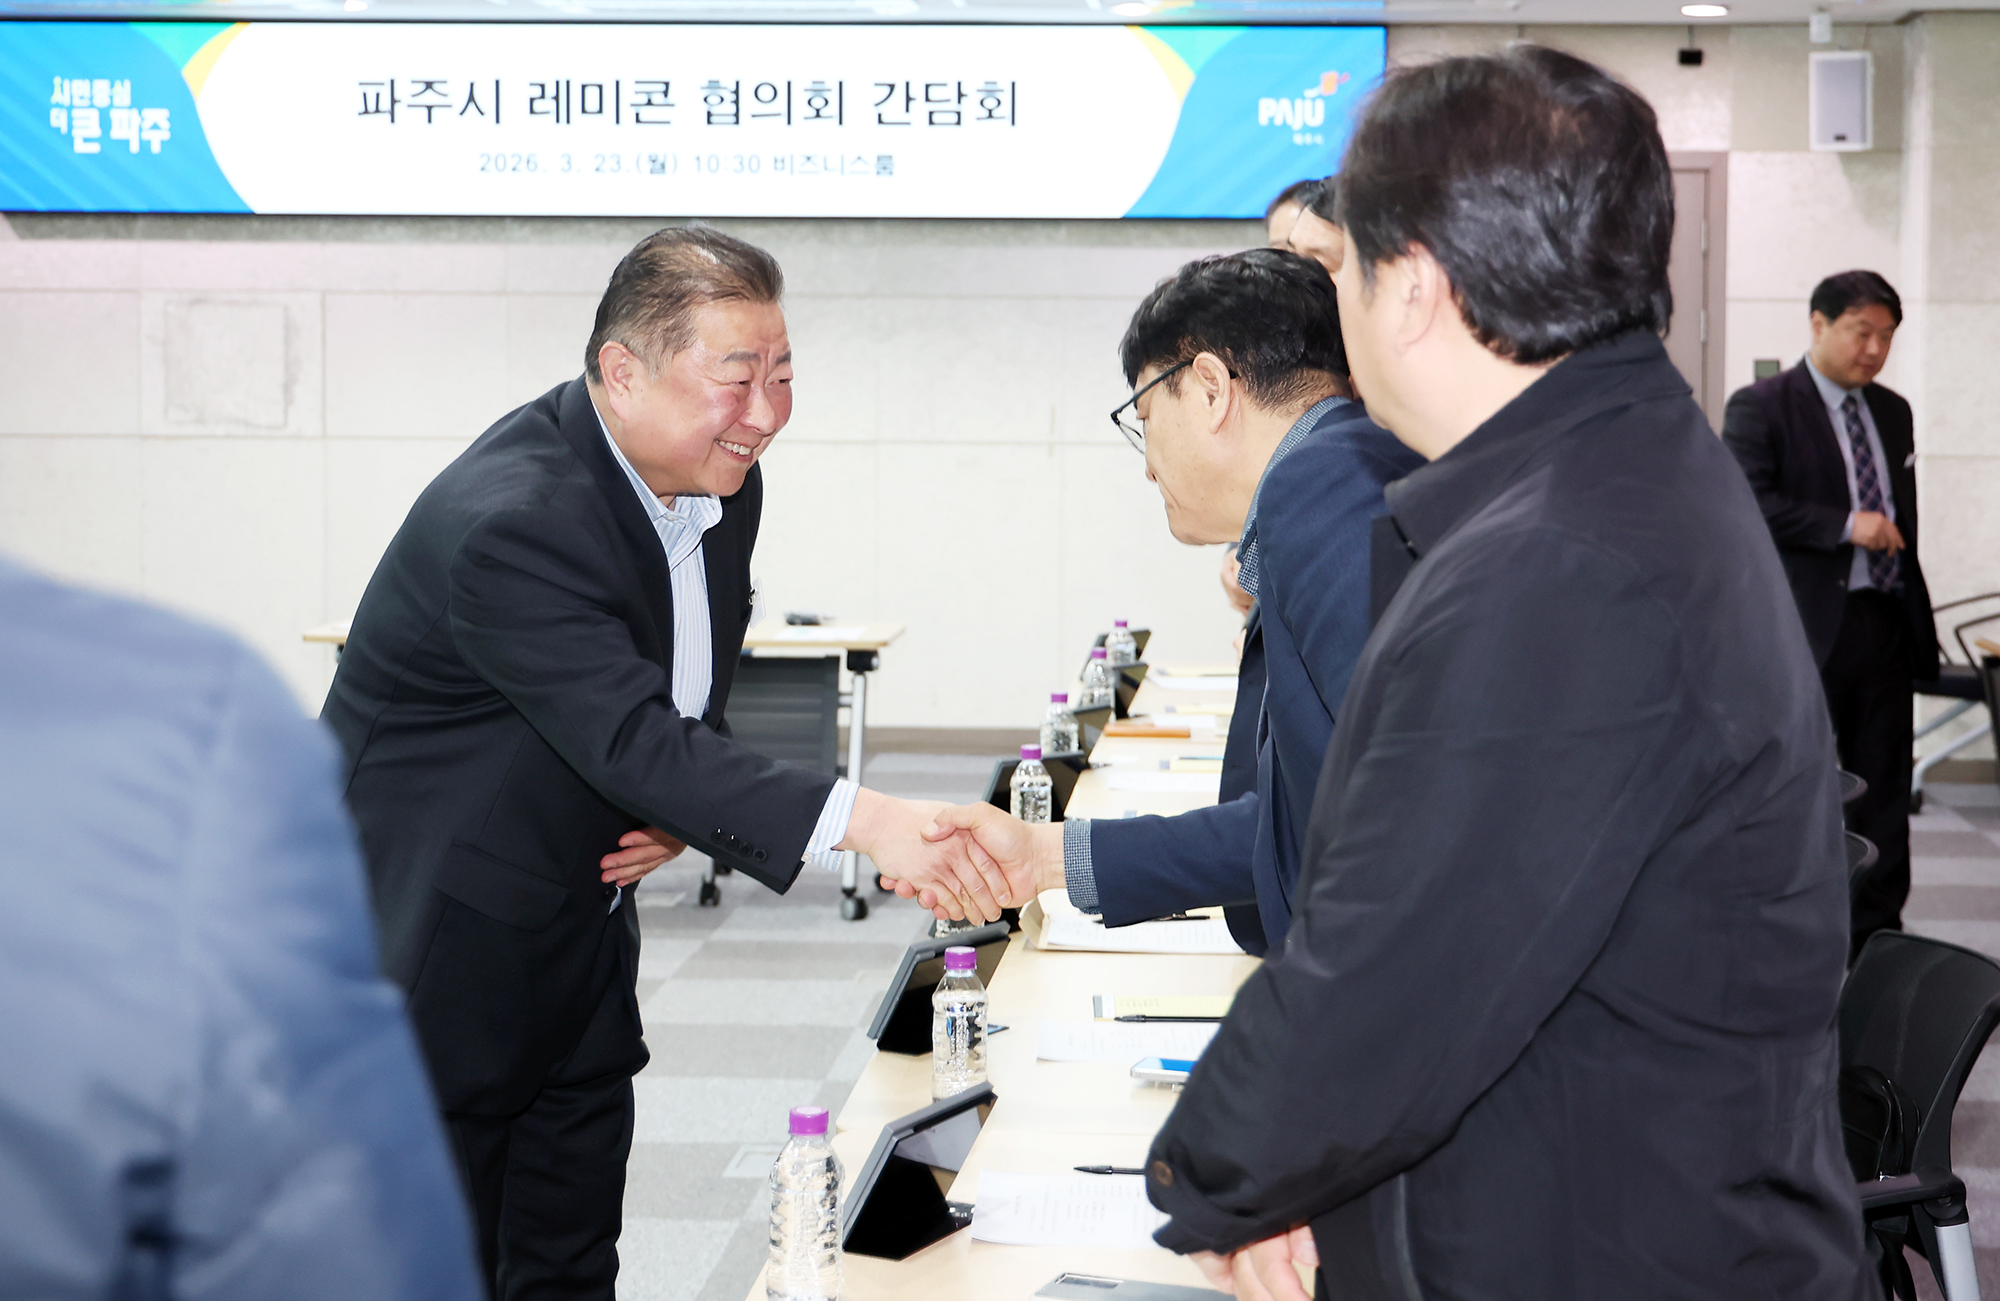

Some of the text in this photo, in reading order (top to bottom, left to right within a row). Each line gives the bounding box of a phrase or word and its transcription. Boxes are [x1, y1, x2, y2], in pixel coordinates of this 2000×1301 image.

[357, 79, 1017, 126] 파주시 레미콘 협의회 간담회
[1258, 97, 1325, 131] PAJU
[71, 107, 102, 154] 큰
[109, 107, 171, 154] 파주
[479, 153, 547, 173] 2026.
[560, 153, 581, 173] 3.
[694, 154, 761, 174] 10:30
[773, 154, 895, 176] 비즈니스룸
